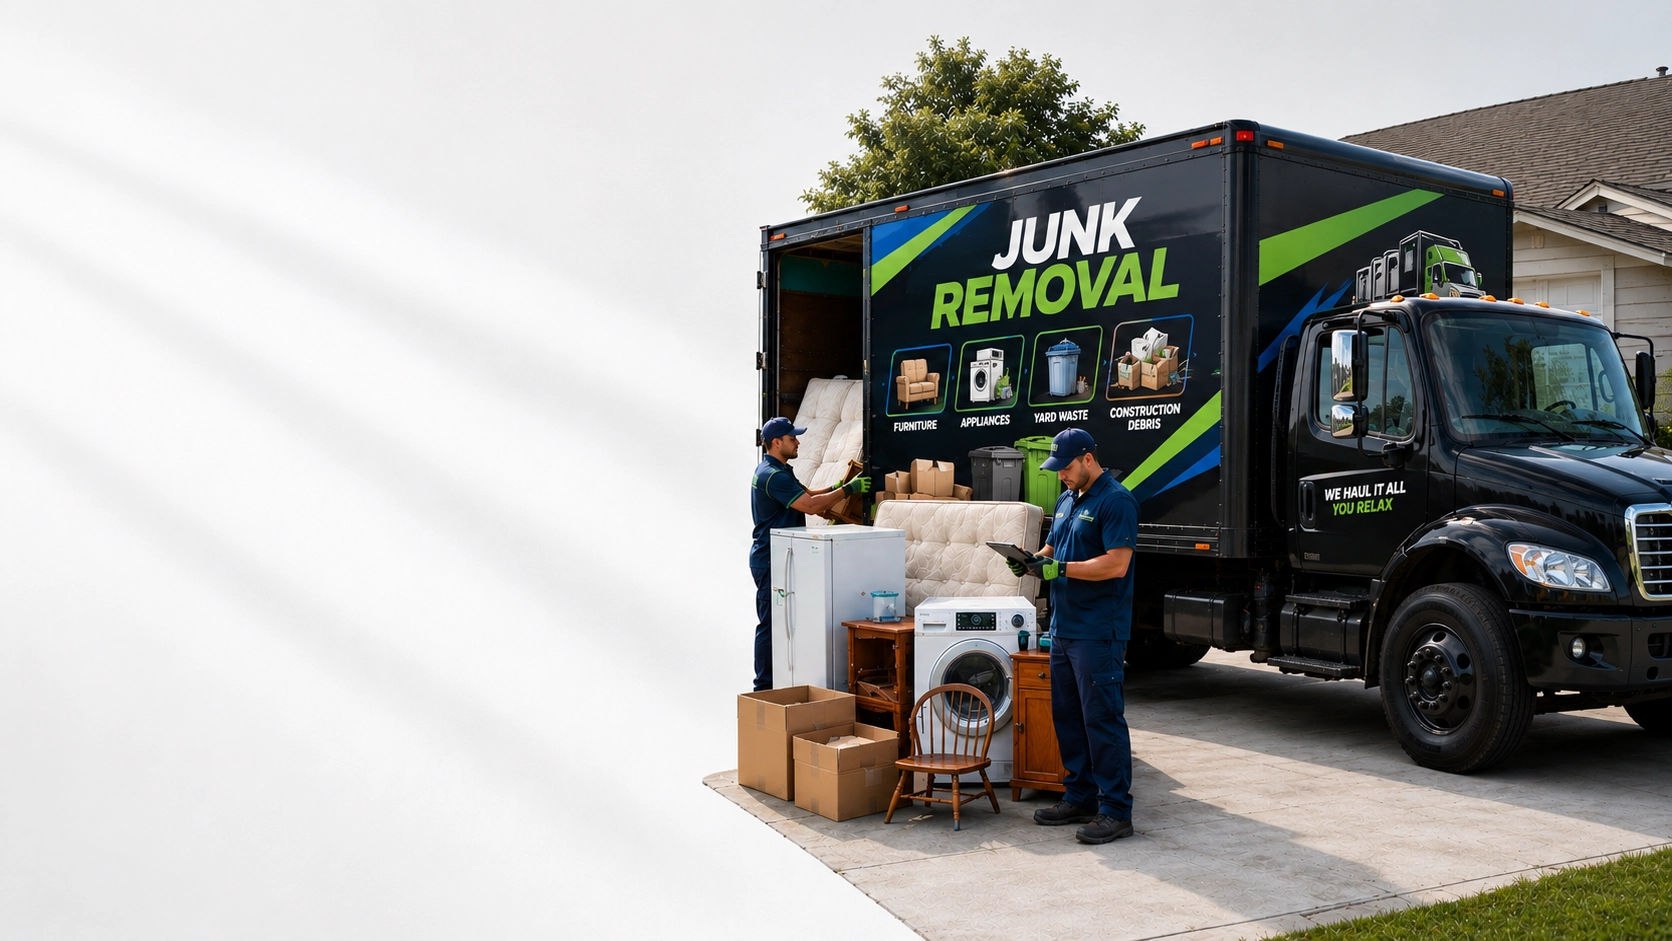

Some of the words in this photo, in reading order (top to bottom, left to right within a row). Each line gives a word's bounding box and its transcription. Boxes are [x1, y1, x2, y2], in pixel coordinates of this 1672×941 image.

[992, 196, 1142, 270] JUNK
[930, 247, 1179, 329] REMOVAL
[1033, 411, 1057, 424] YARD
[1058, 409, 1089, 422] WASTE
[1109, 402, 1181, 419] CONSTRUCTION
[893, 419, 938, 432] FURNITURE
[960, 414, 1011, 428] APPLIANCES
[1127, 417, 1161, 431] DEBRIS
[1324, 488, 1341, 501] WE
[1343, 485, 1371, 499] HAUL
[1373, 483, 1384, 496] IT
[1385, 481, 1406, 494] ALL
[1332, 502, 1354, 515] YOU
[1356, 498, 1393, 513] RELAX
